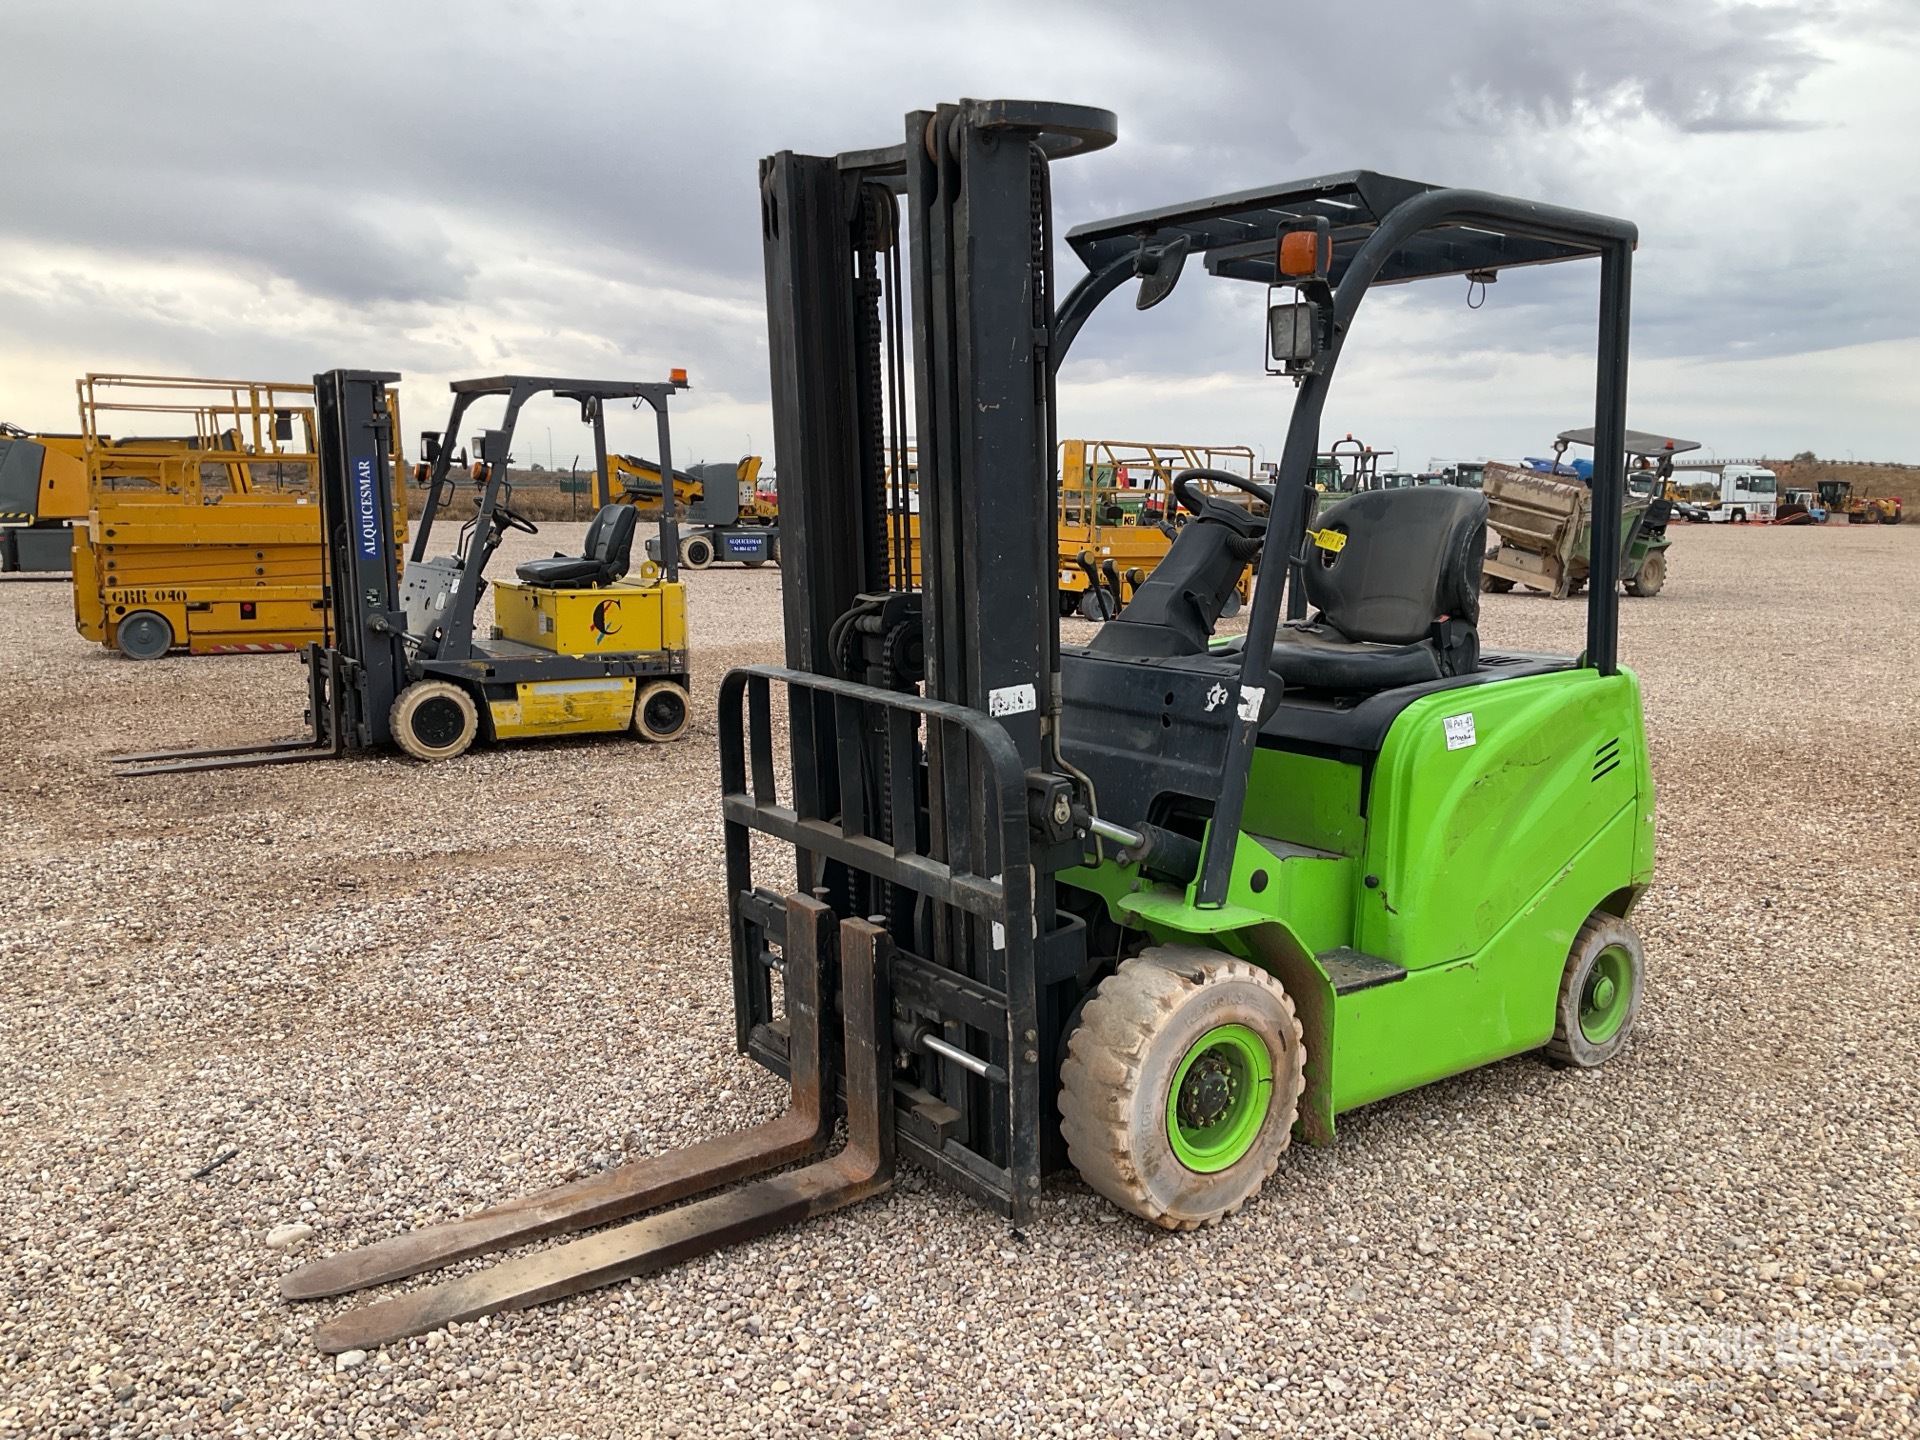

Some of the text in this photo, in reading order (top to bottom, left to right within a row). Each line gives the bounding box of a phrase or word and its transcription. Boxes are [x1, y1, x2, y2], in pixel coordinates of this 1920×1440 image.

[358, 460, 377, 555] ALQUICESMAR
[112, 589, 187, 604] GRR 040
